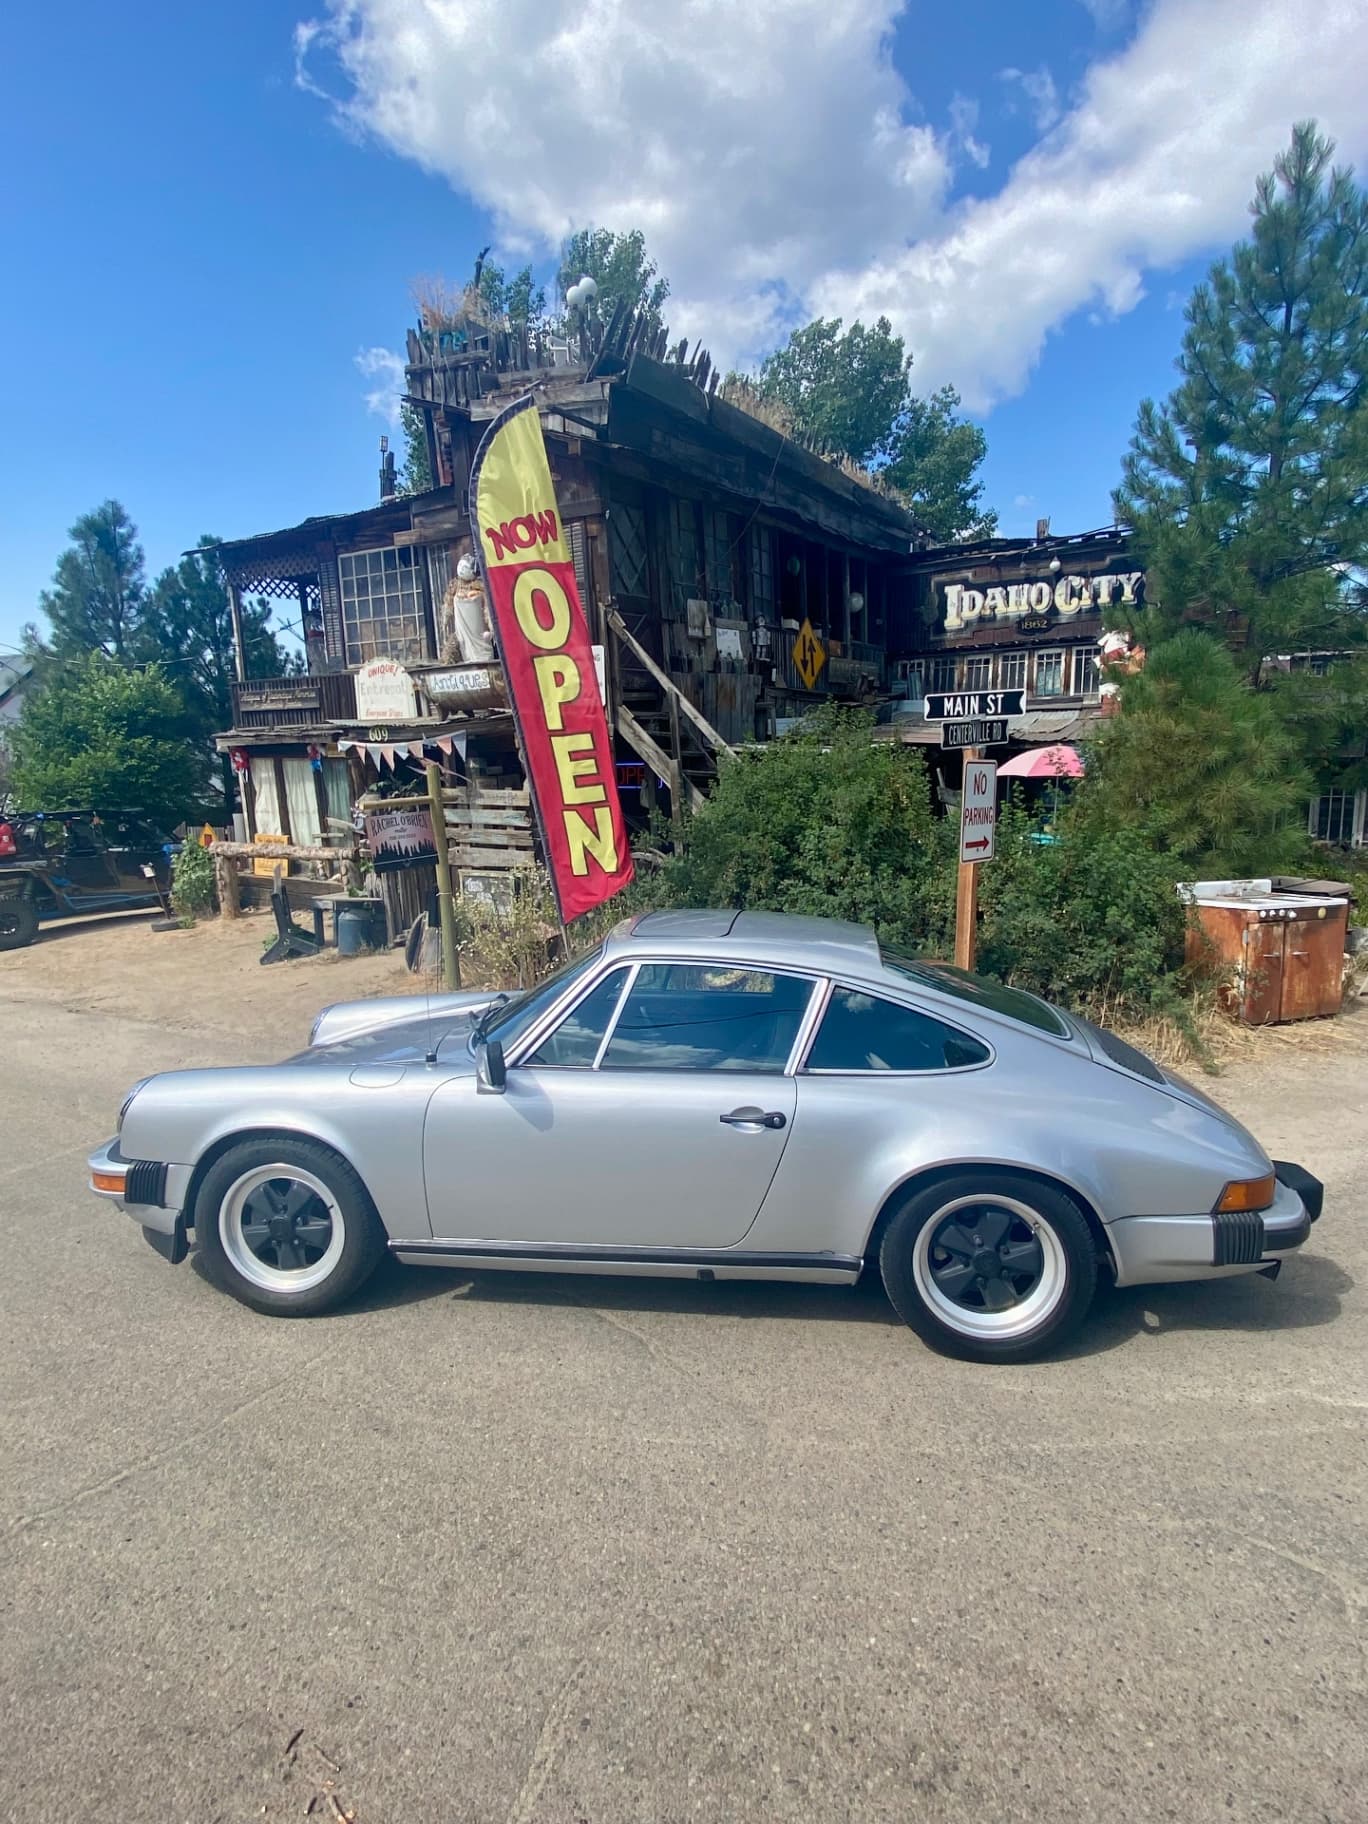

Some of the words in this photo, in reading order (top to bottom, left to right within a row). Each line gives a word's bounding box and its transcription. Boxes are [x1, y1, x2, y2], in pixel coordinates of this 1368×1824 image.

[486, 508, 558, 560] NOW
[944, 582, 1053, 630] IDAHO
[1055, 572, 1145, 615] CITY
[1021, 618, 1049, 631] 1862
[943, 695, 979, 716] MAIN
[986, 694, 1004, 714] ST
[513, 567, 620, 877] OPEN
[948, 722, 990, 745] CENTERVILLE
[369, 727, 388, 742] 609
[973, 771, 988, 796] NO
[964, 806, 994, 826] PARKING
